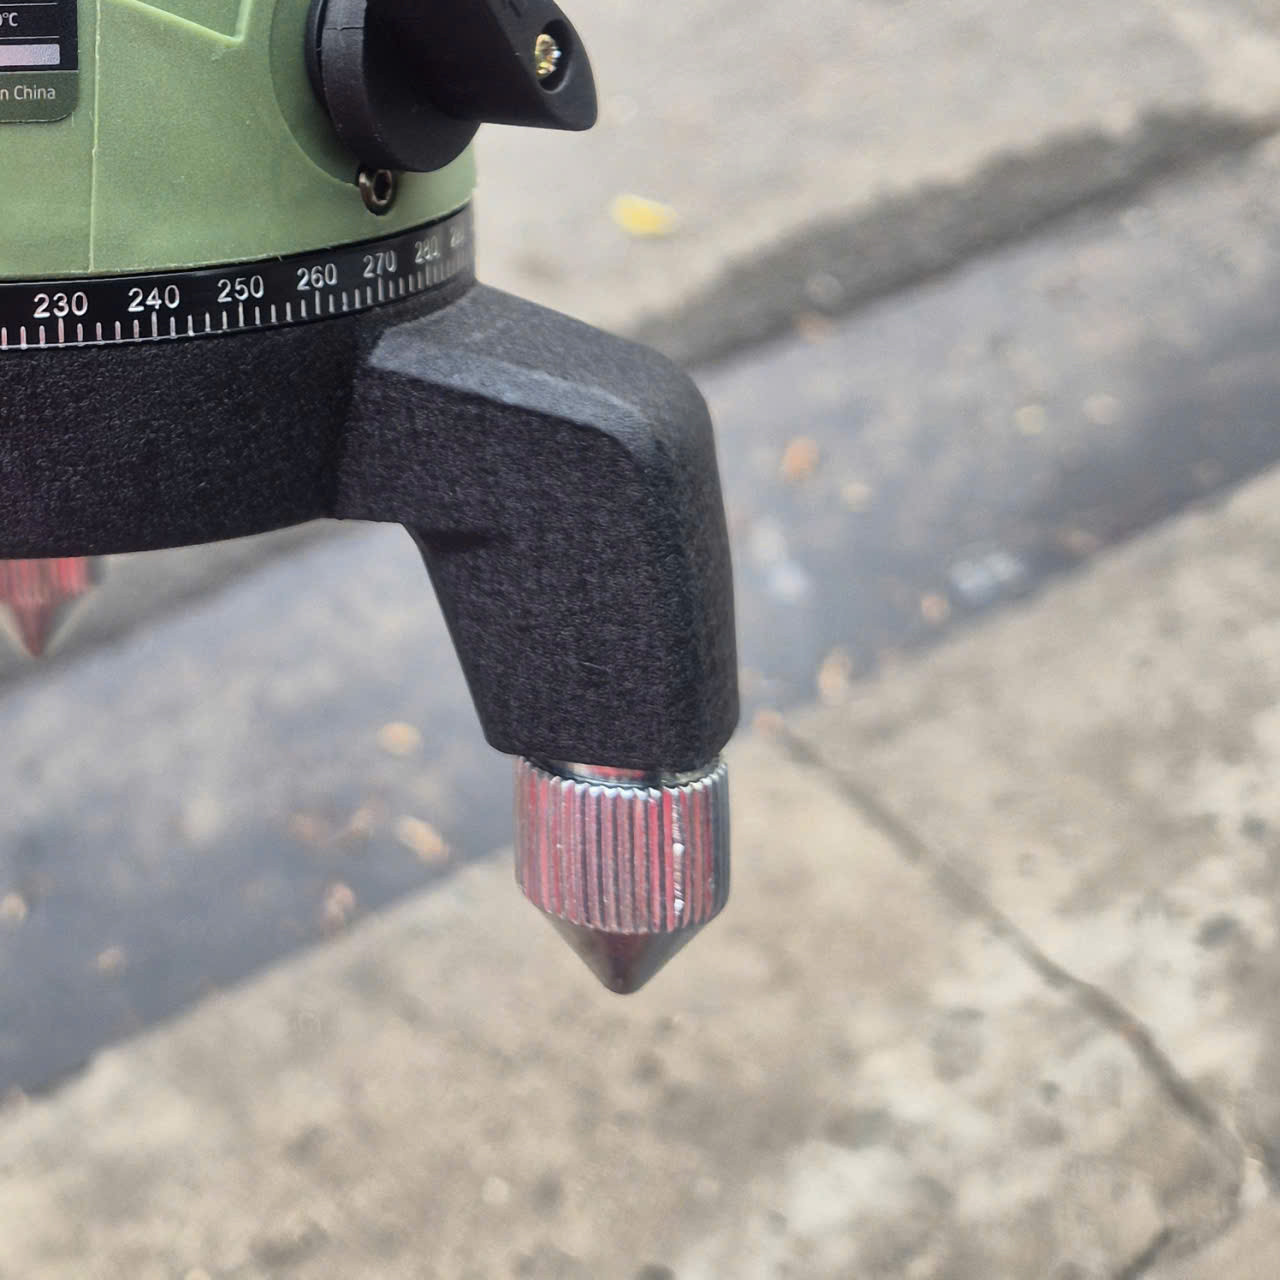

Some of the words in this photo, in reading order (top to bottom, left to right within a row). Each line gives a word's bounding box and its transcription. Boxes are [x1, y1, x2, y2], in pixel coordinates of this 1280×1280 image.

[13, 85, 56, 100] China
[33, 291, 88, 318] 230
[128, 285, 181, 312] 240
[217, 275, 265, 303] 250
[297, 263, 338, 290] 260
[363, 250, 398, 278] 270
